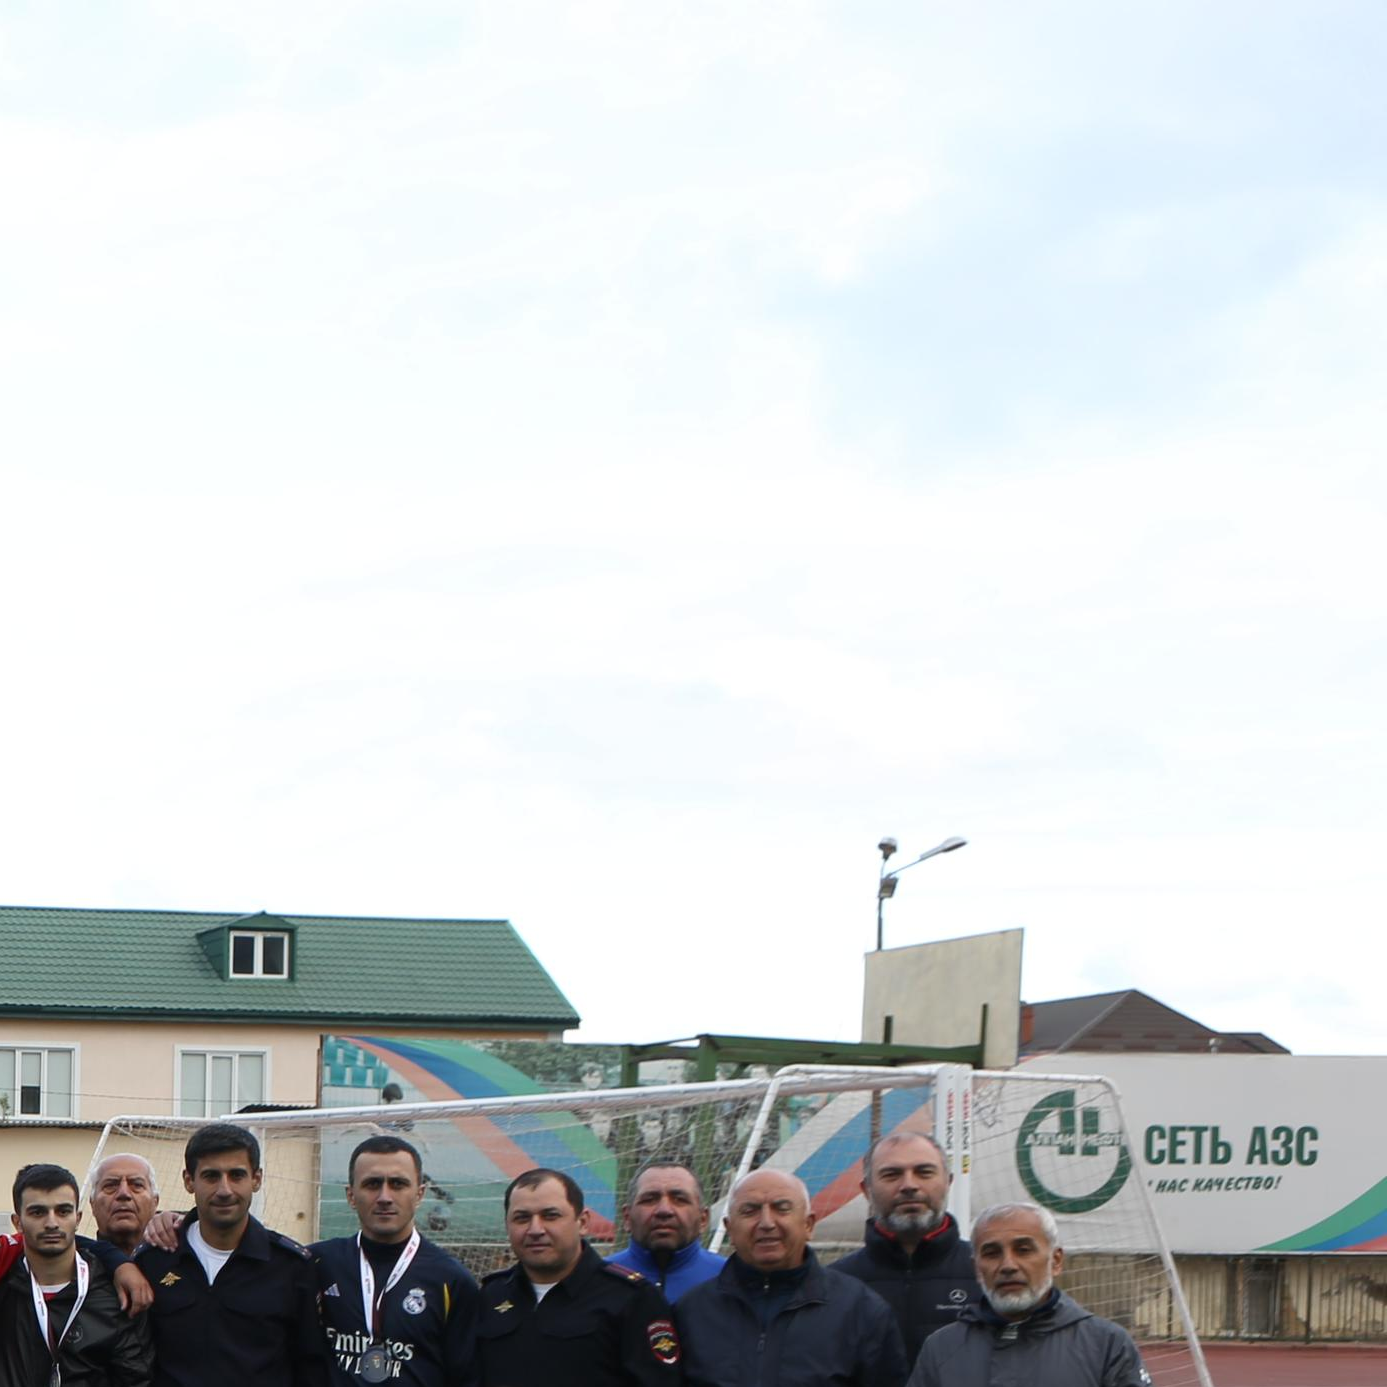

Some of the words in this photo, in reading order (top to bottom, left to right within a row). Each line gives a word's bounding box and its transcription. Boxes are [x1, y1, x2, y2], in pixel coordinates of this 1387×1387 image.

[1144, 1124, 1232, 1166] СЕТЬ
[1246, 1125, 1319, 1166] АЗС
[1155, 1179, 1189, 1194] НАС
[1191, 1175, 1283, 1193] КАЧЕСТВО!
[326, 1327, 414, 1361] Emirtes
